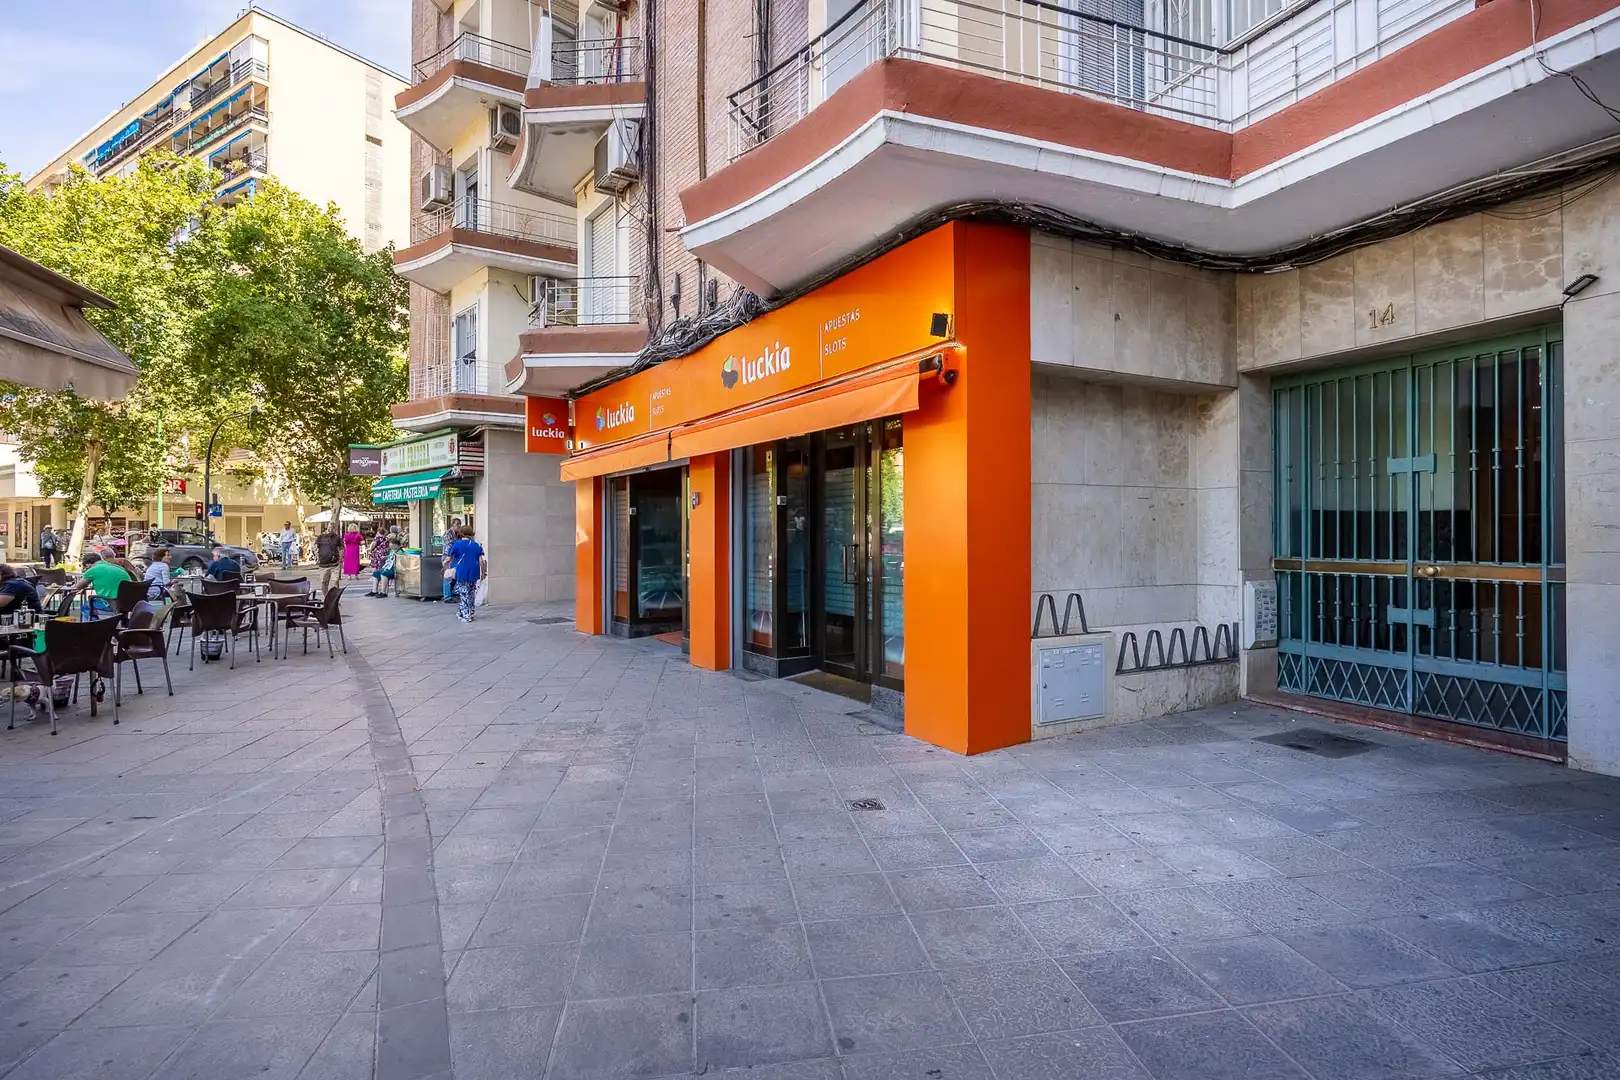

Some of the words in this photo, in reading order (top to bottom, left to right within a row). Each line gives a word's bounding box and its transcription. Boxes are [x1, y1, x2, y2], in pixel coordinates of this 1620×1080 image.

[824, 308, 860, 333] APUESTAS
[1368, 301, 1395, 329] 14
[824, 337, 847, 356] SLOTS
[741, 341, 791, 385] luckia
[606, 400, 635, 429] luckia
[531, 426, 565, 439] luckia
